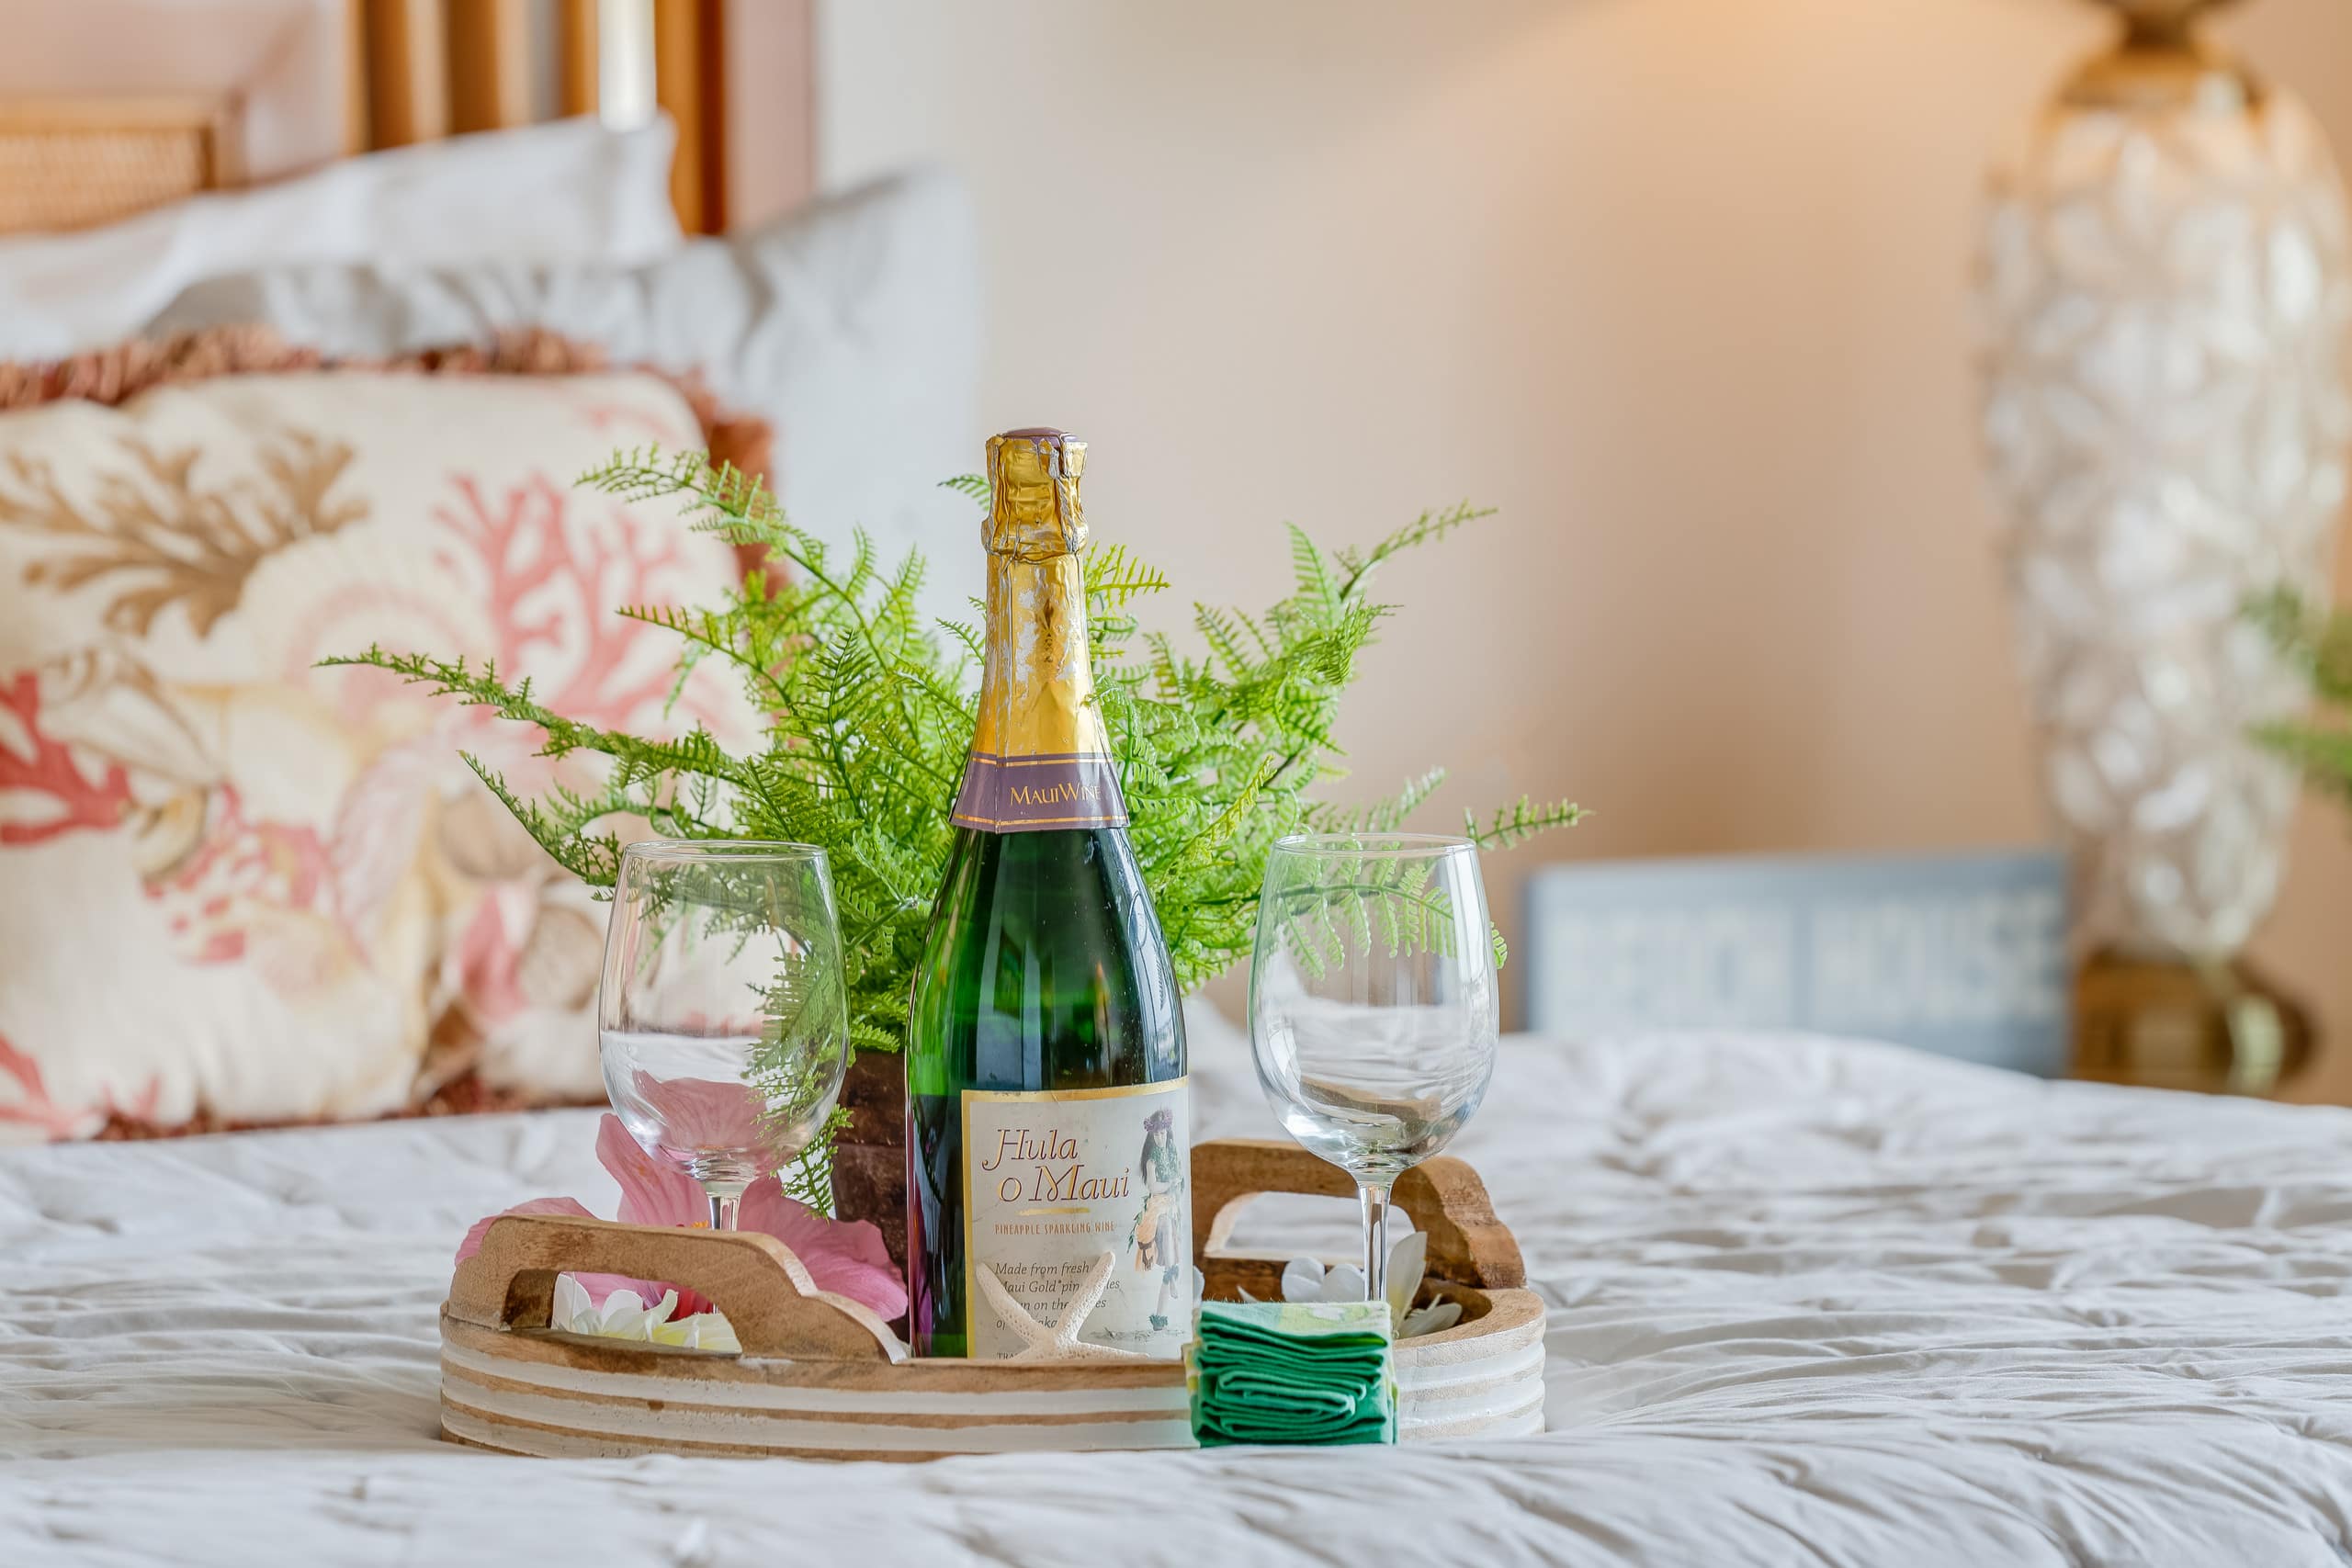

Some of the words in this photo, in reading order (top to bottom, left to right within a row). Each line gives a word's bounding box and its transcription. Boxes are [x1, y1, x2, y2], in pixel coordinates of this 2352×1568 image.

[981, 1129, 1080, 1171] Hula
[998, 1178, 1023, 1202] o
[1028, 1164, 1130, 1202] Maui
[995, 1223, 1041, 1235] PINEAPPLE
[1045, 1223, 1091, 1235] SPARKLING
[1094, 1221, 1114, 1233] WINE
[995, 1262, 1027, 1274] Made
[1030, 1263, 1057, 1277] from
[1061, 1261, 1090, 1277] fresh
[1034, 1303, 1048, 1311] on
